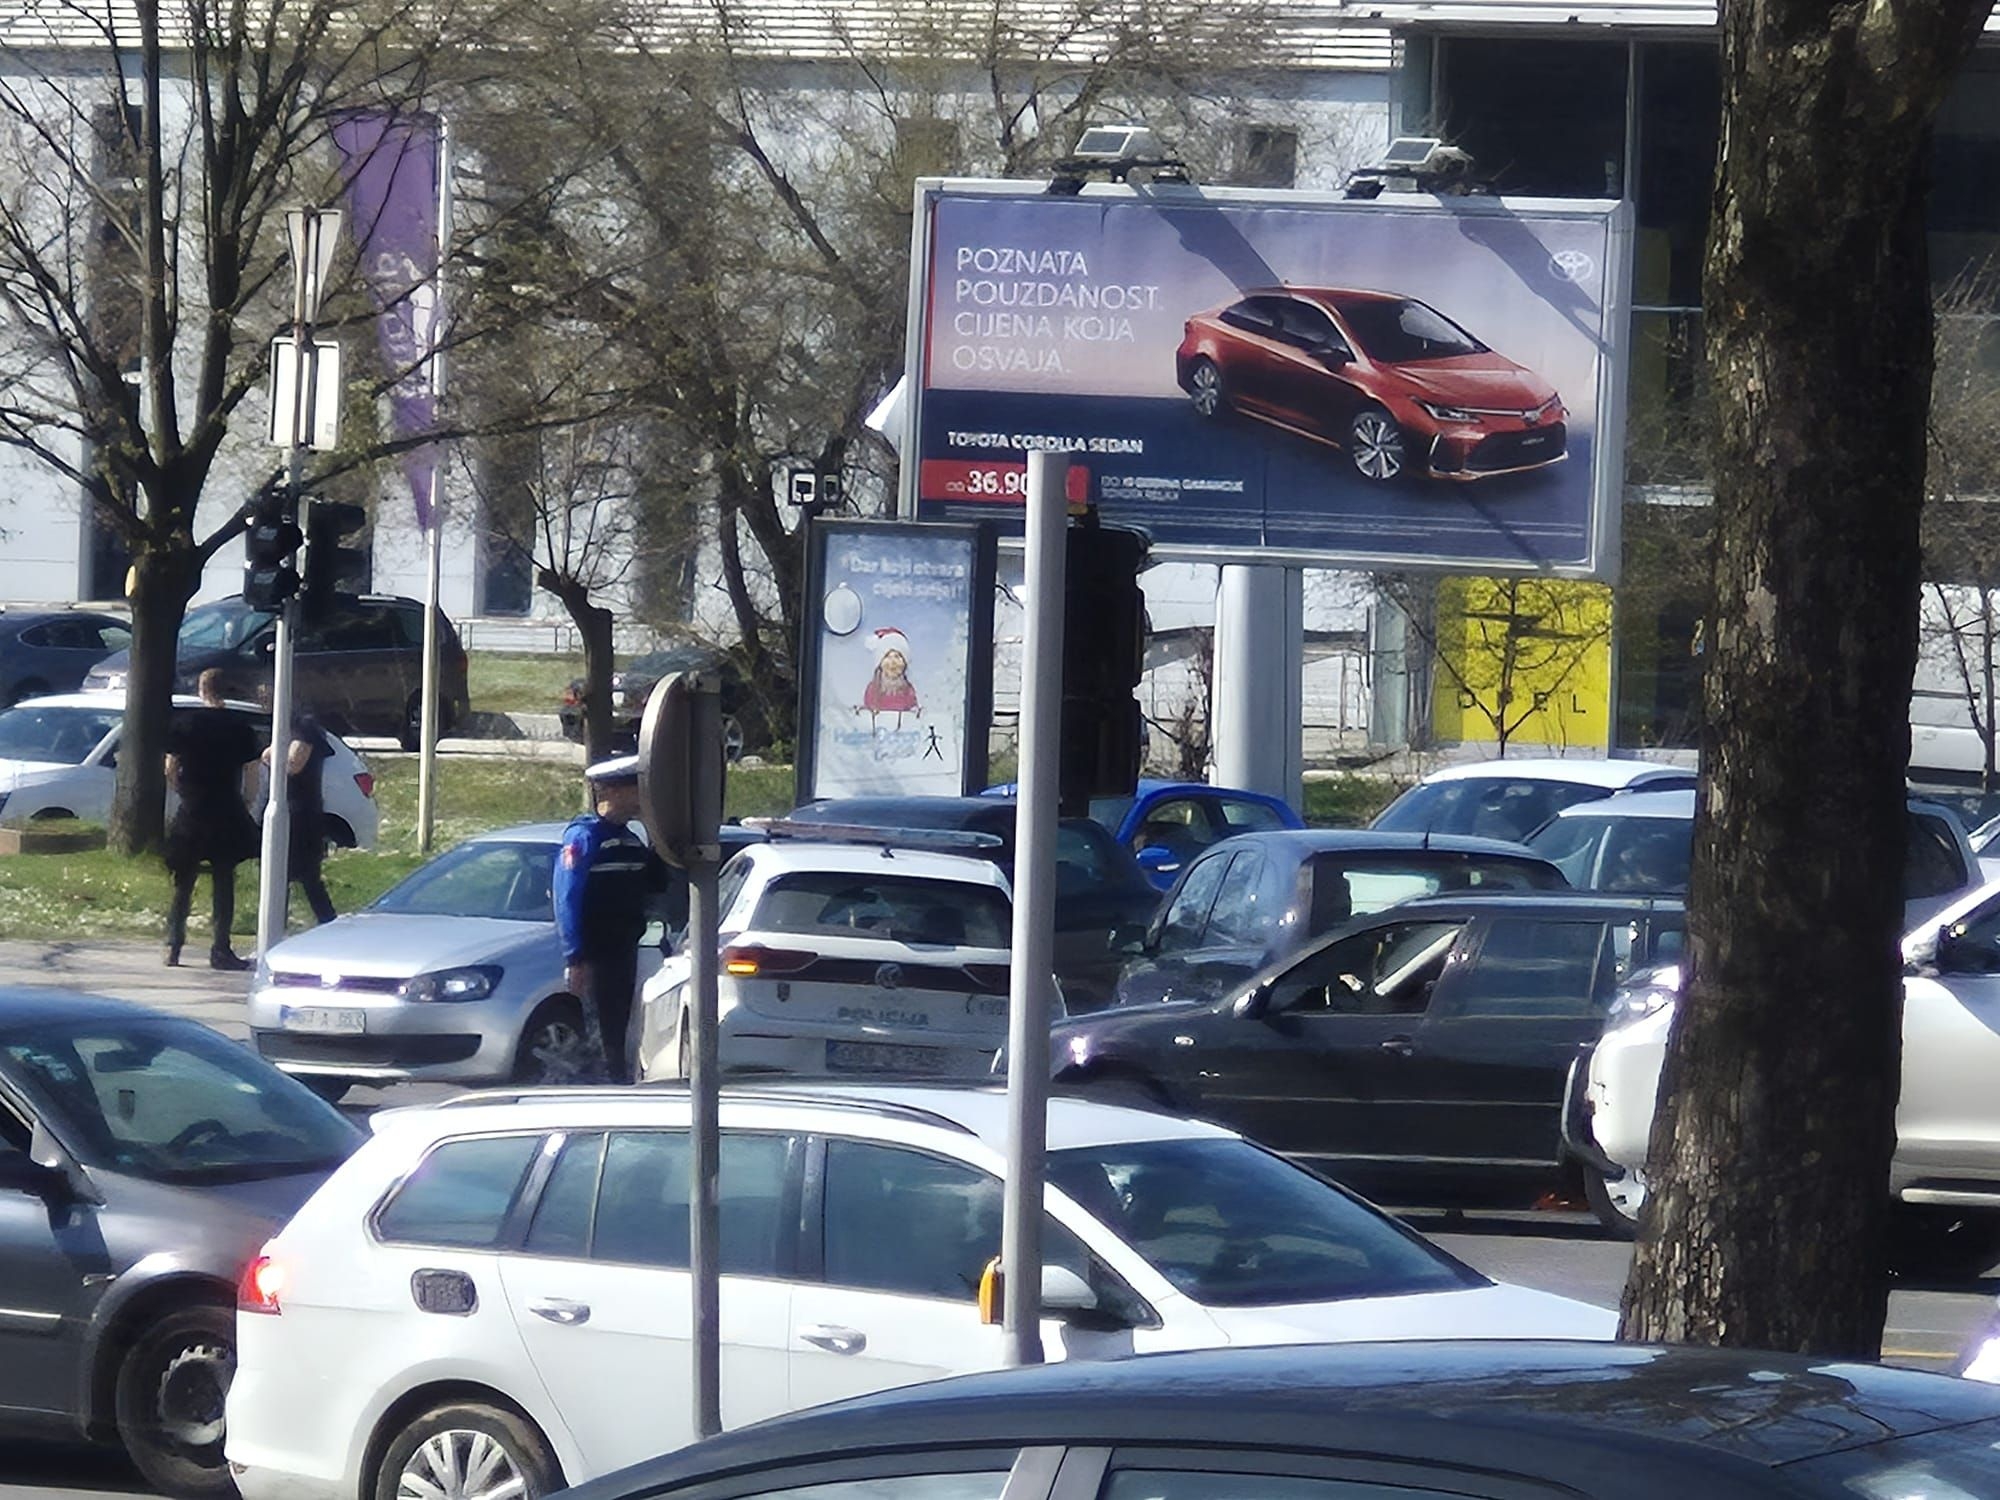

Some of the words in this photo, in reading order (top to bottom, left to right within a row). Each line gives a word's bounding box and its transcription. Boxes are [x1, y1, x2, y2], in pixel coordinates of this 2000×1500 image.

[956, 247, 1088, 276] POZNATA
[955, 279, 1164, 311] POUZDANOST.
[954, 311, 1054, 338] CIJENA
[1063, 315, 1135, 343] KOJA
[952, 345, 1072, 374] OSVAJA.
[948, 431, 1009, 449] TOYOTA
[1011, 434, 1087, 452] COROLLA
[1088, 437, 1144, 454] SEDAN
